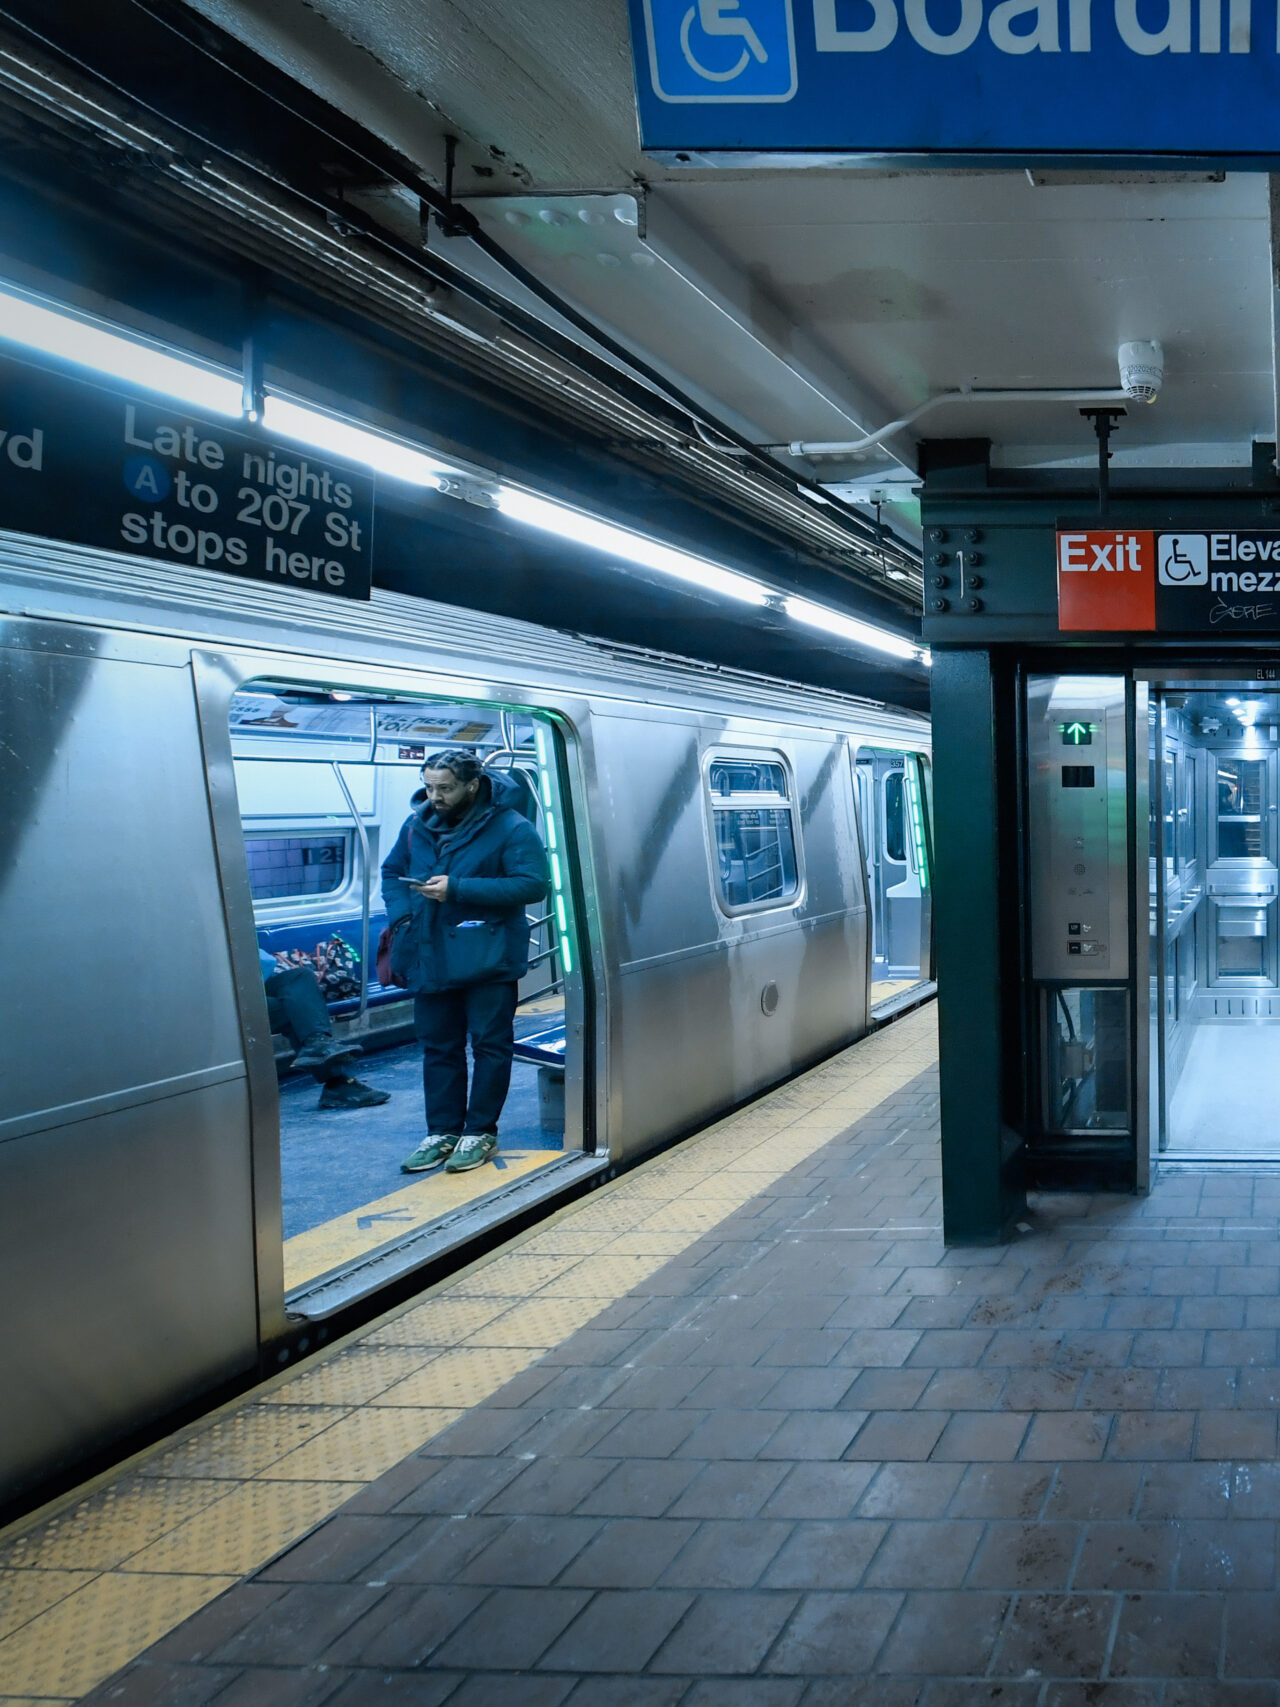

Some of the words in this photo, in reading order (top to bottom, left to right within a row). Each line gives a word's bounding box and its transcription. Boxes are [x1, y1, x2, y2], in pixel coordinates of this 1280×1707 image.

[0, 427, 43, 471] d
[124, 403, 225, 470] Late
[242, 451, 353, 509] nights
[134, 464, 159, 495] A
[173, 470, 219, 514] to
[236, 487, 311, 535] 207
[324, 511, 362, 552] St
[120, 510, 248, 566] stops
[265, 536, 346, 586] here
[1060, 534, 1142, 572] Exit
[1256, 669, 1264, 680] EL
